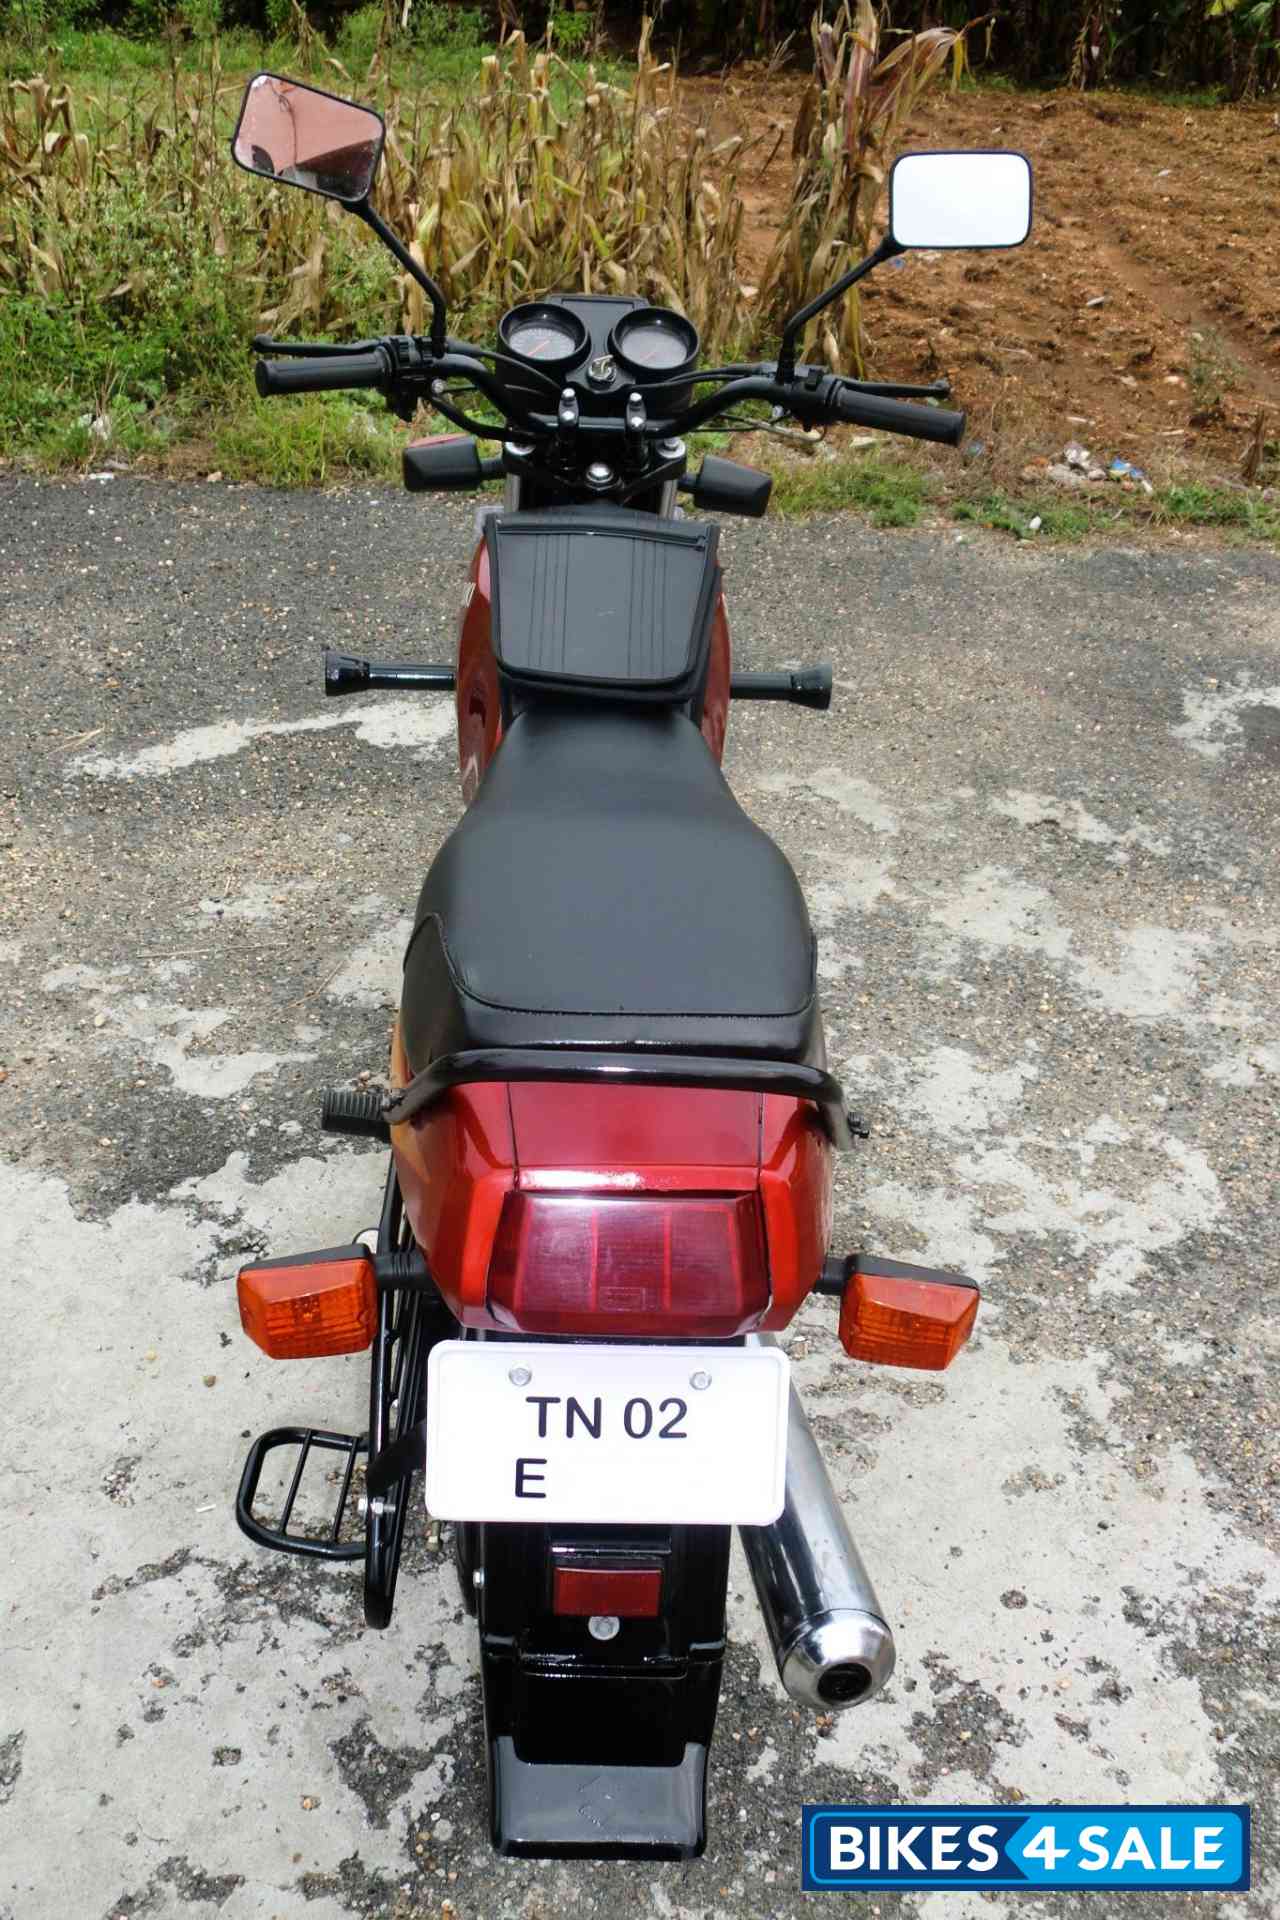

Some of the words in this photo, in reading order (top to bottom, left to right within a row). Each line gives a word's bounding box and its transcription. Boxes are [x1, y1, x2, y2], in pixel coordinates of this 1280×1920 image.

[526, 1396, 601, 1438] TN
[624, 1397, 688, 1439] 02
[515, 1458, 547, 1498] E
